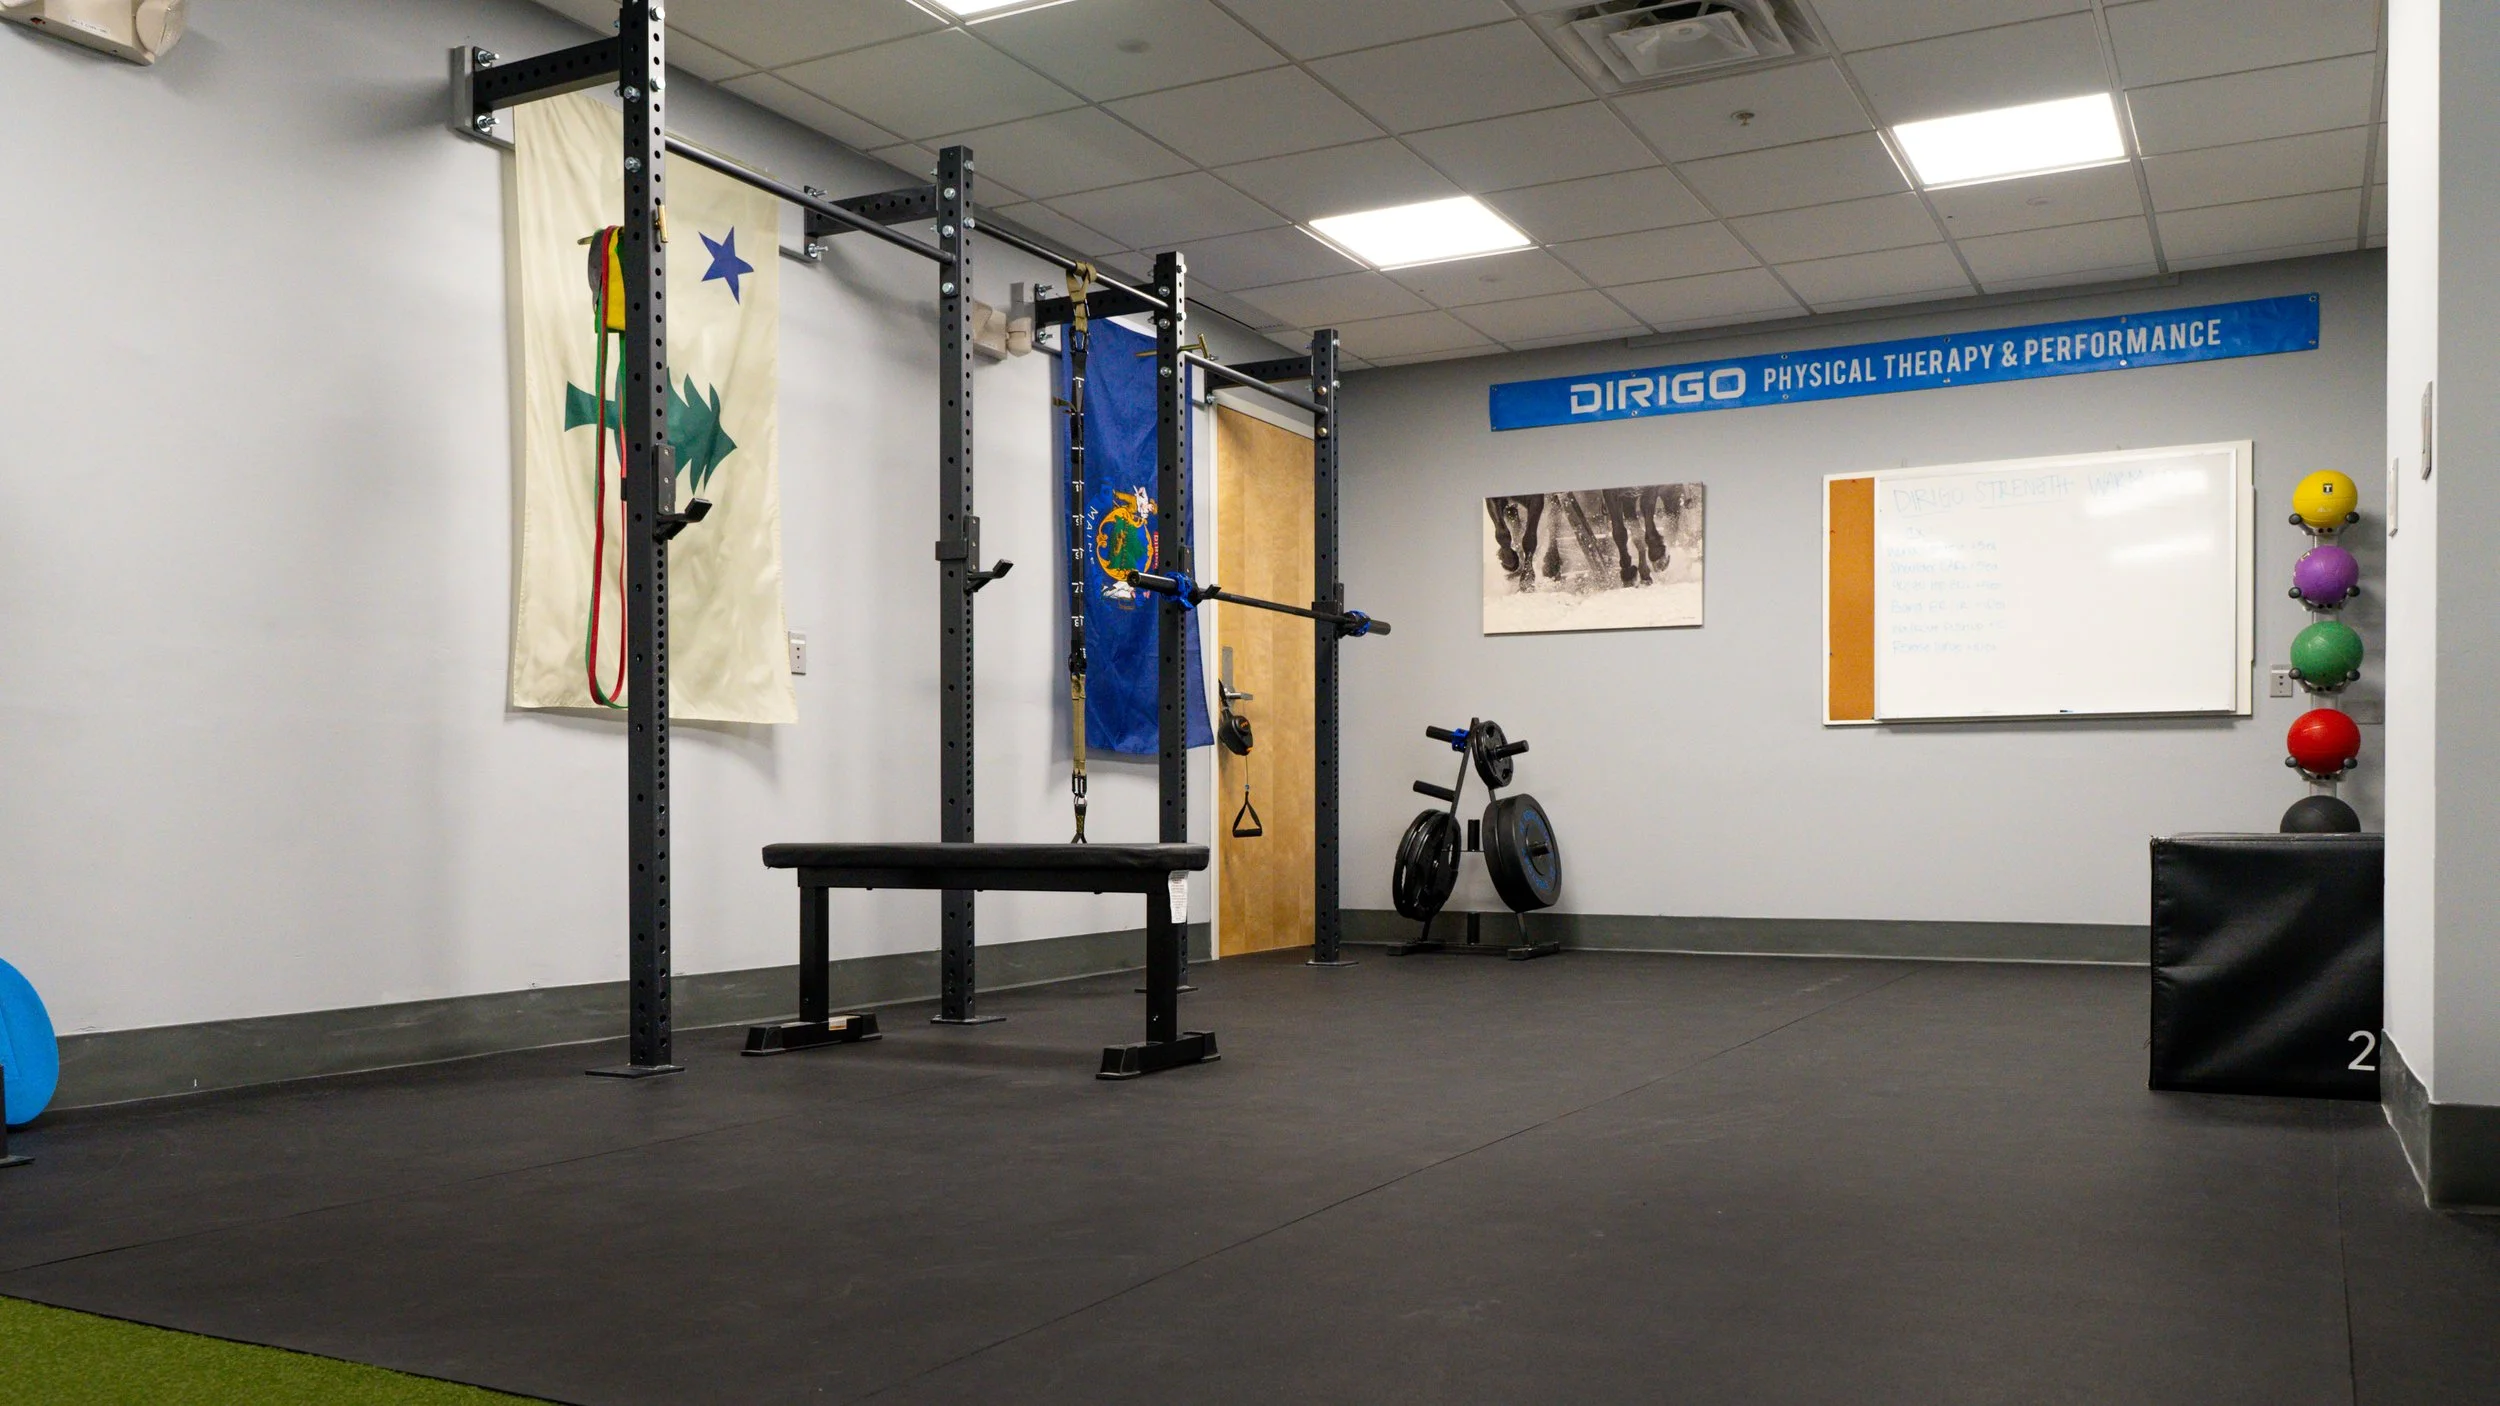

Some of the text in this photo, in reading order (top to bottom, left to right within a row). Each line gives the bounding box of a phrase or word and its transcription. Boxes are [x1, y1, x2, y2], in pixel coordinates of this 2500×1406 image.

[1570, 318, 2222, 414] DIRIGO PHYSICAL THERAPY & PERFORMANCE
[1893, 486, 1964, 513] DIRIGO
[1975, 474, 2070, 503] STRENGTH
